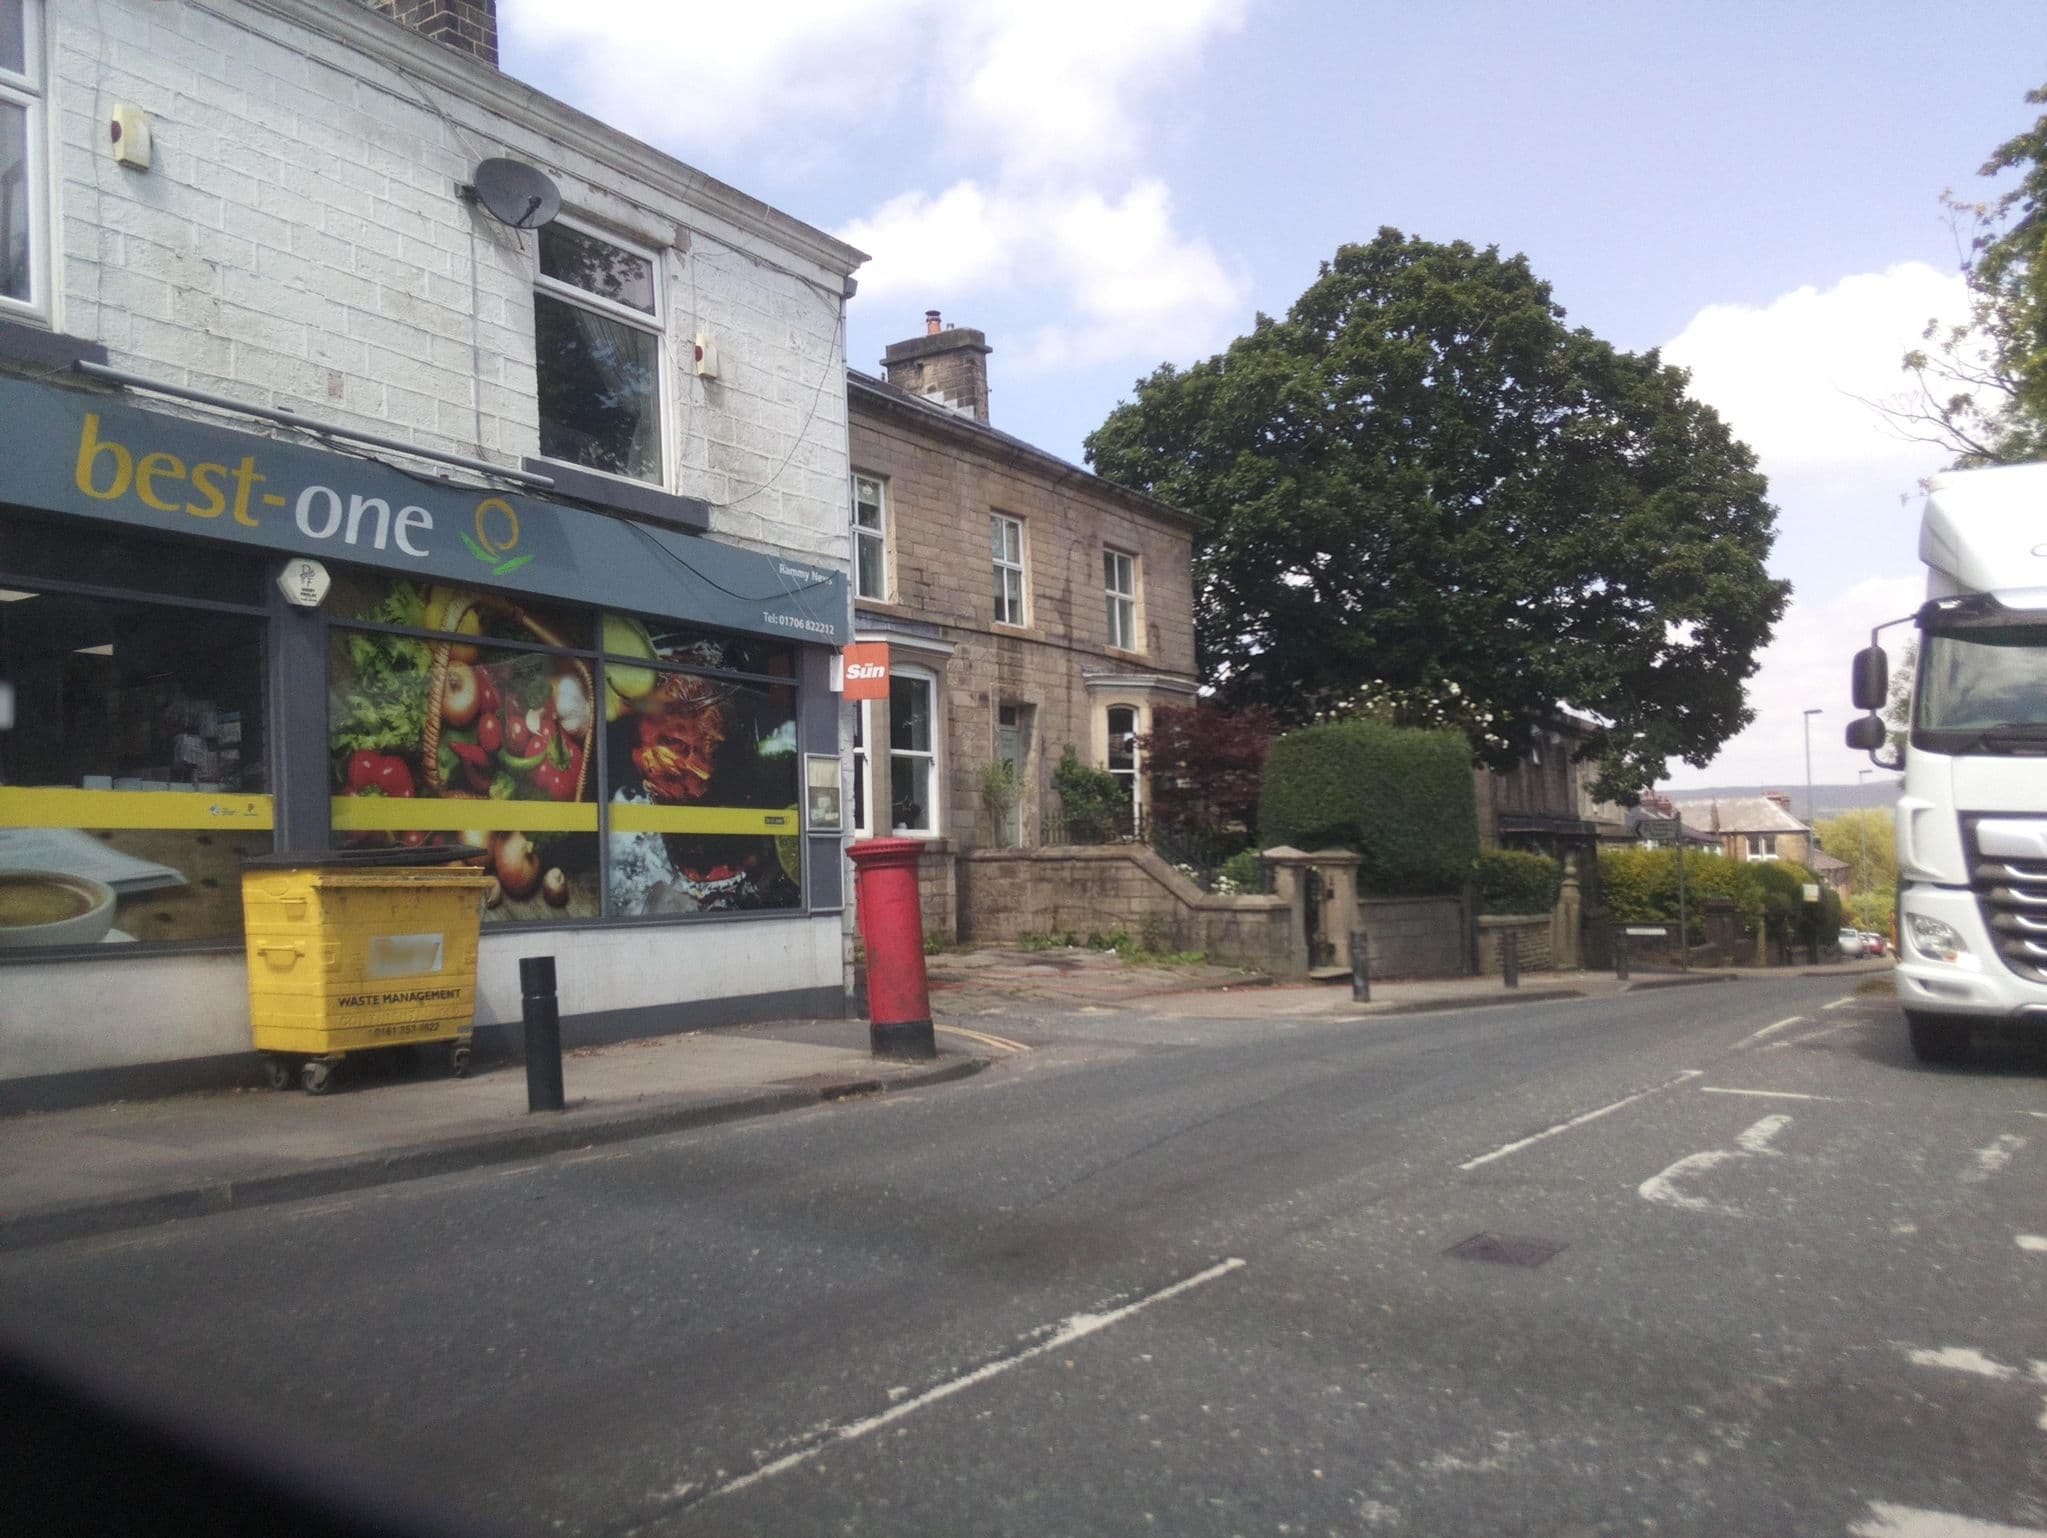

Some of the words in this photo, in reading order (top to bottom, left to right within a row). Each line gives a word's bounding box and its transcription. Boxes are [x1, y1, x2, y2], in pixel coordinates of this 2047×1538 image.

[779, 564, 810, 582] Rammy
[763, 612, 778, 625] Tel:
[779, 615, 805, 629] 01706
[805, 621, 835, 635] 822212
[846, 662, 885, 680] Sun
[338, 997, 380, 1007] WASTE
[382, 989, 461, 1004] MANAGEMENT
